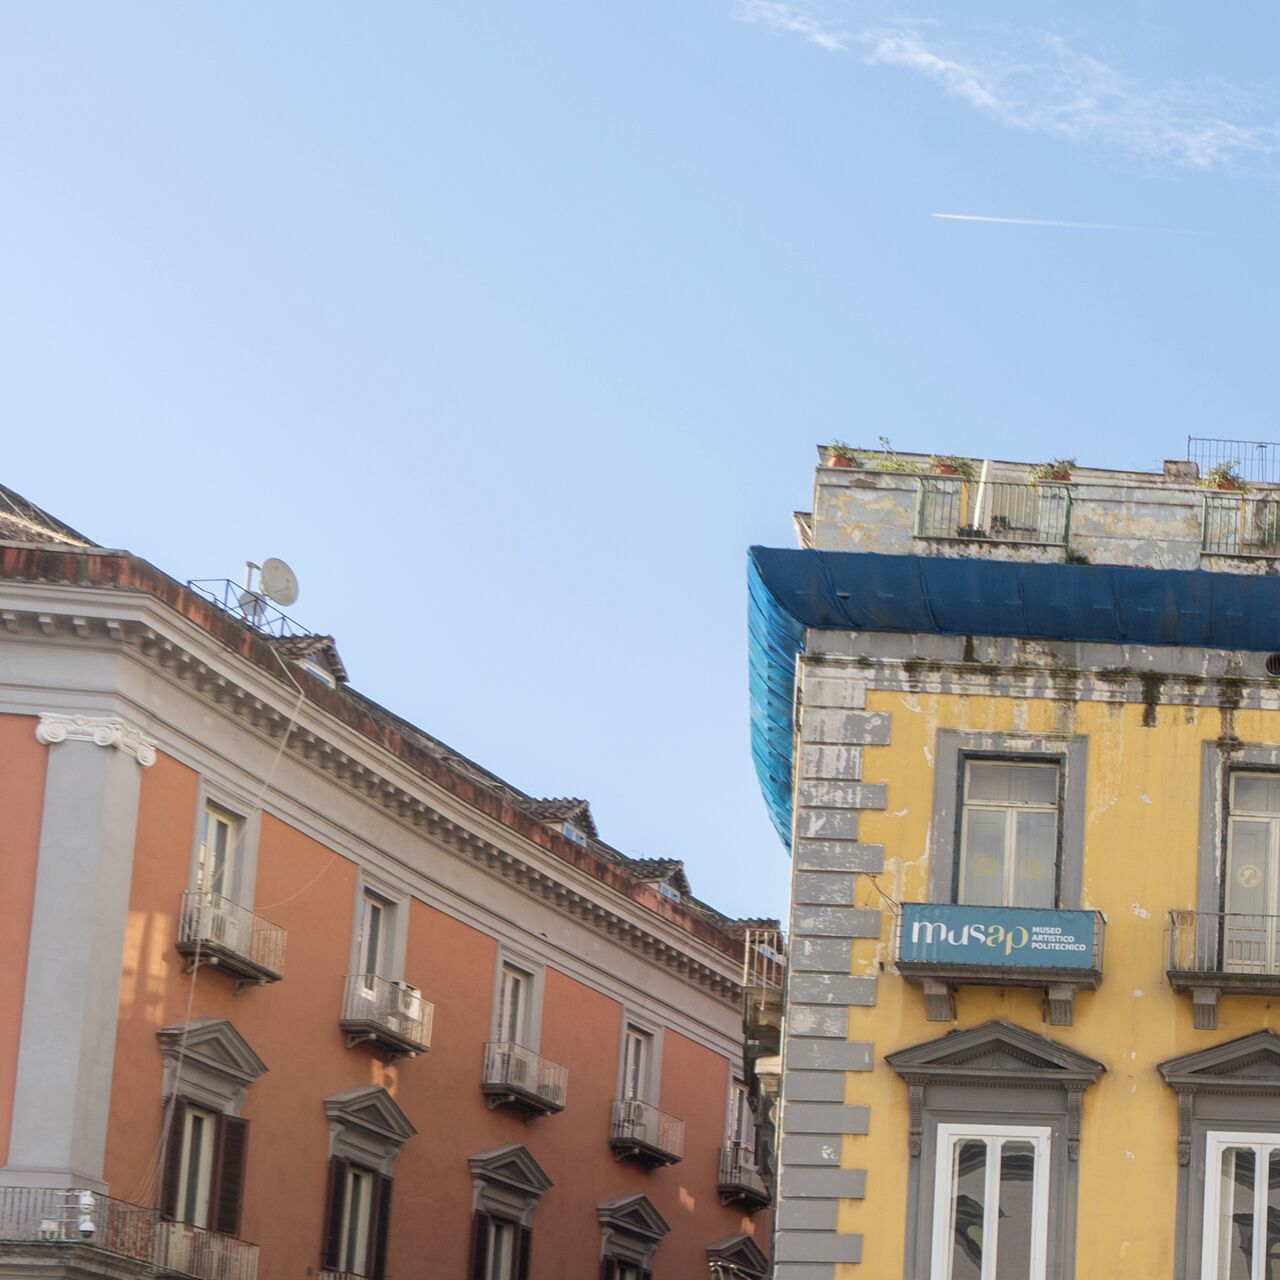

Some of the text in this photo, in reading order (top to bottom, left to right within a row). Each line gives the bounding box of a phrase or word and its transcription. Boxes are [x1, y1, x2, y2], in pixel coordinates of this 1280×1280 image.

[1032, 926, 1062, 935] MUSEO
[912, 921, 1029, 956] musap
[1031, 935, 1075, 944] ARTISTICO
[1031, 942, 1087, 952] POLITECNICO
